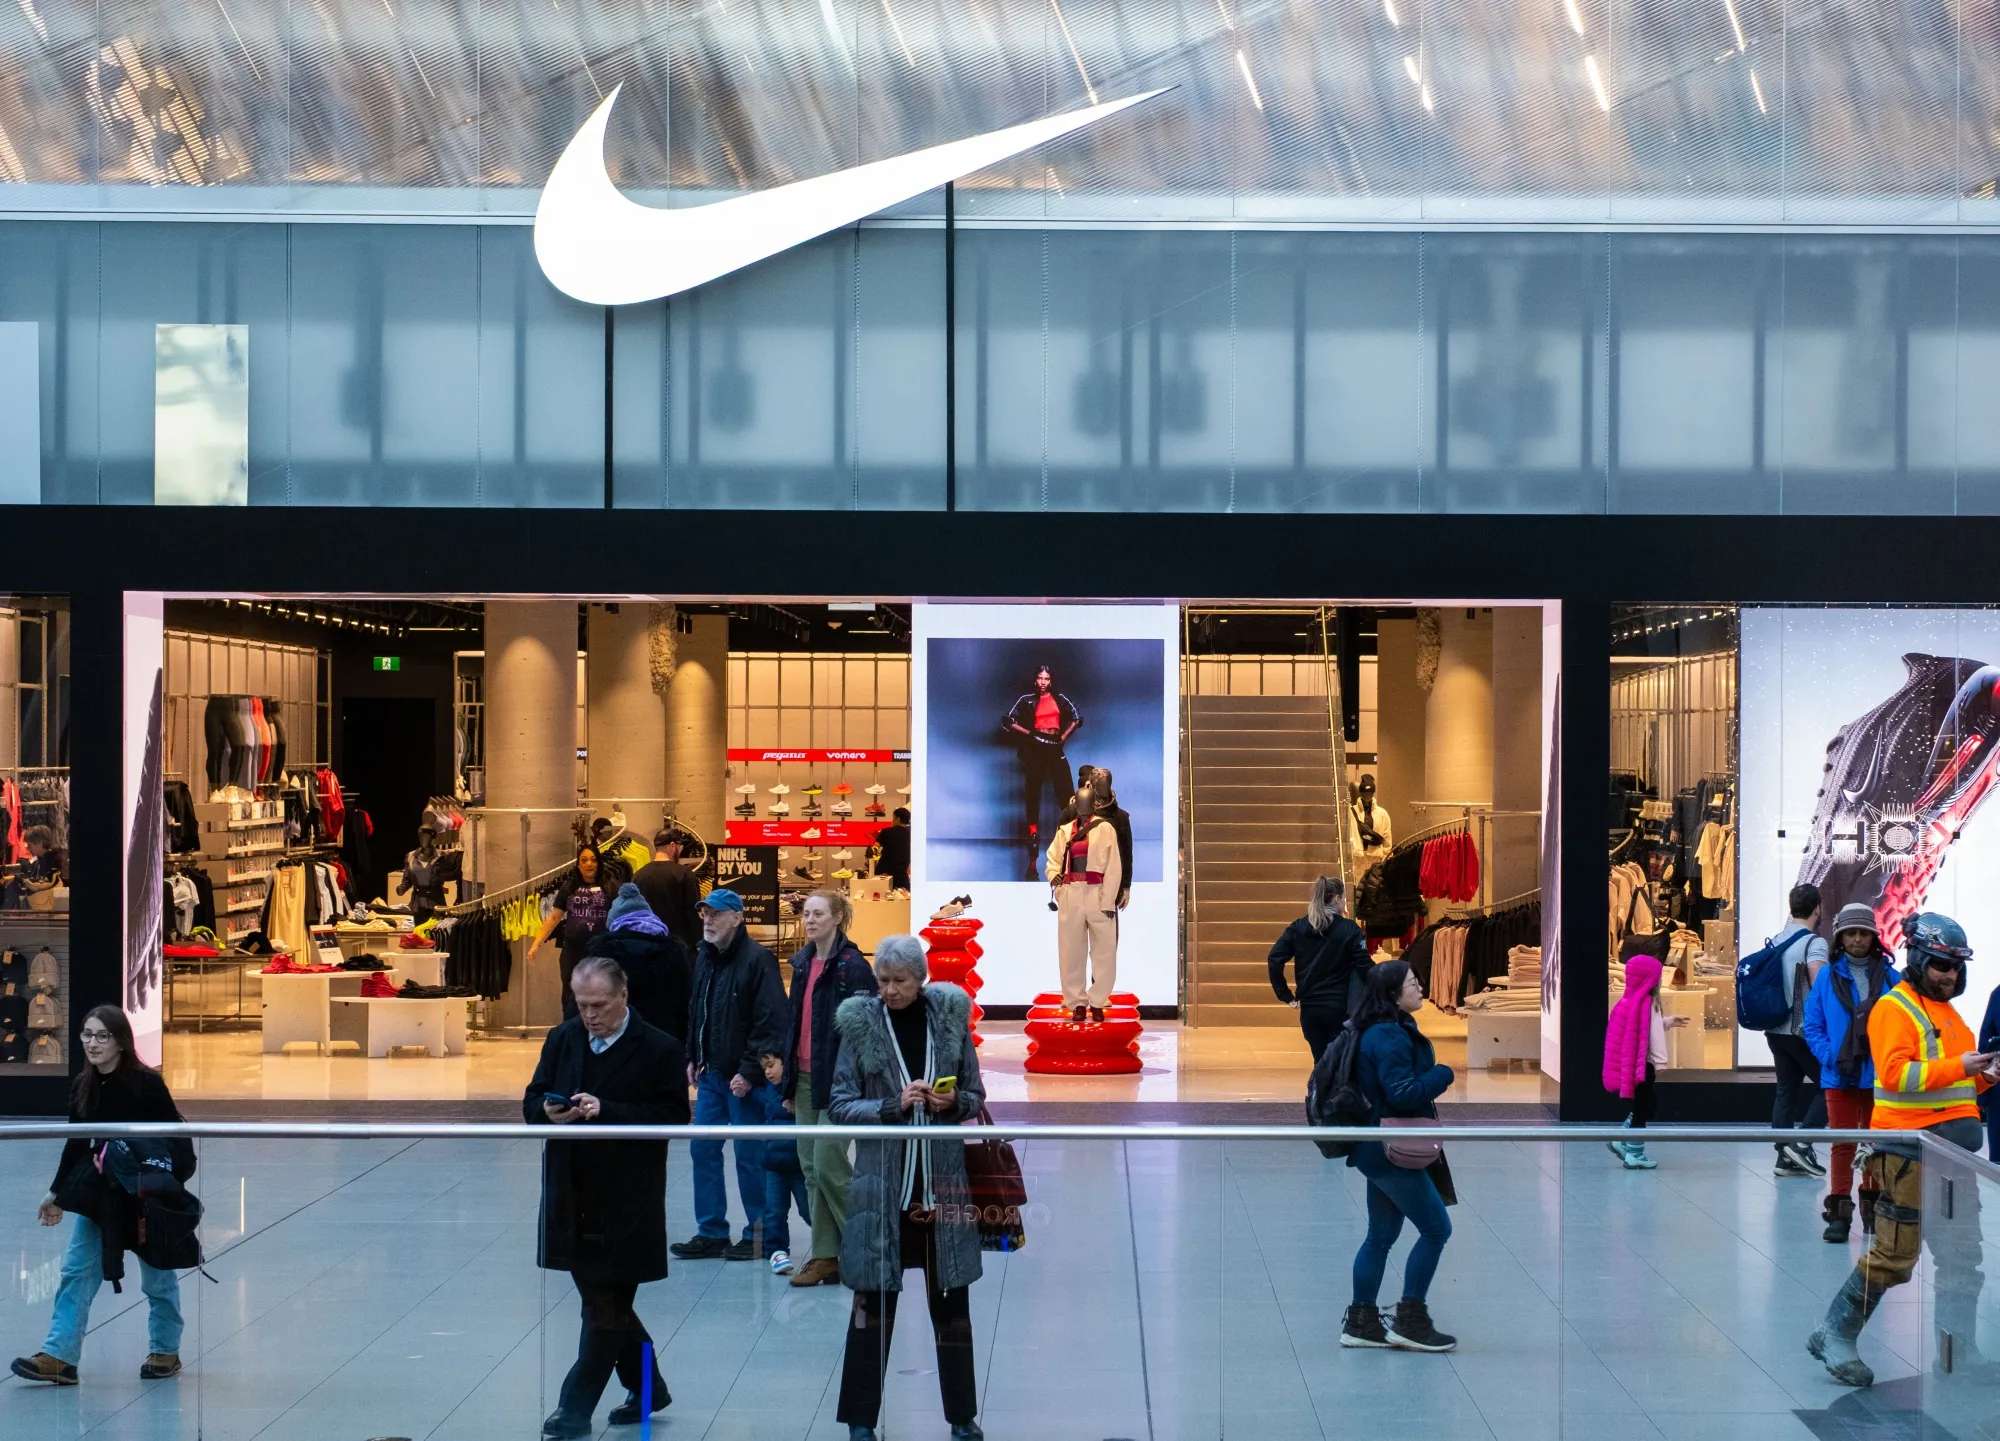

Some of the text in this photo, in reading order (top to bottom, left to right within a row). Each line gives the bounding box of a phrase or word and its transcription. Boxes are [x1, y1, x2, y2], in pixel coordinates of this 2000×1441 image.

[763, 752, 807, 760] pegasus
[826, 752, 866, 760] vomero
[718, 848, 747, 861] NIKE
[718, 862, 762, 875] BY YOU
[574, 896, 589, 905] OR
